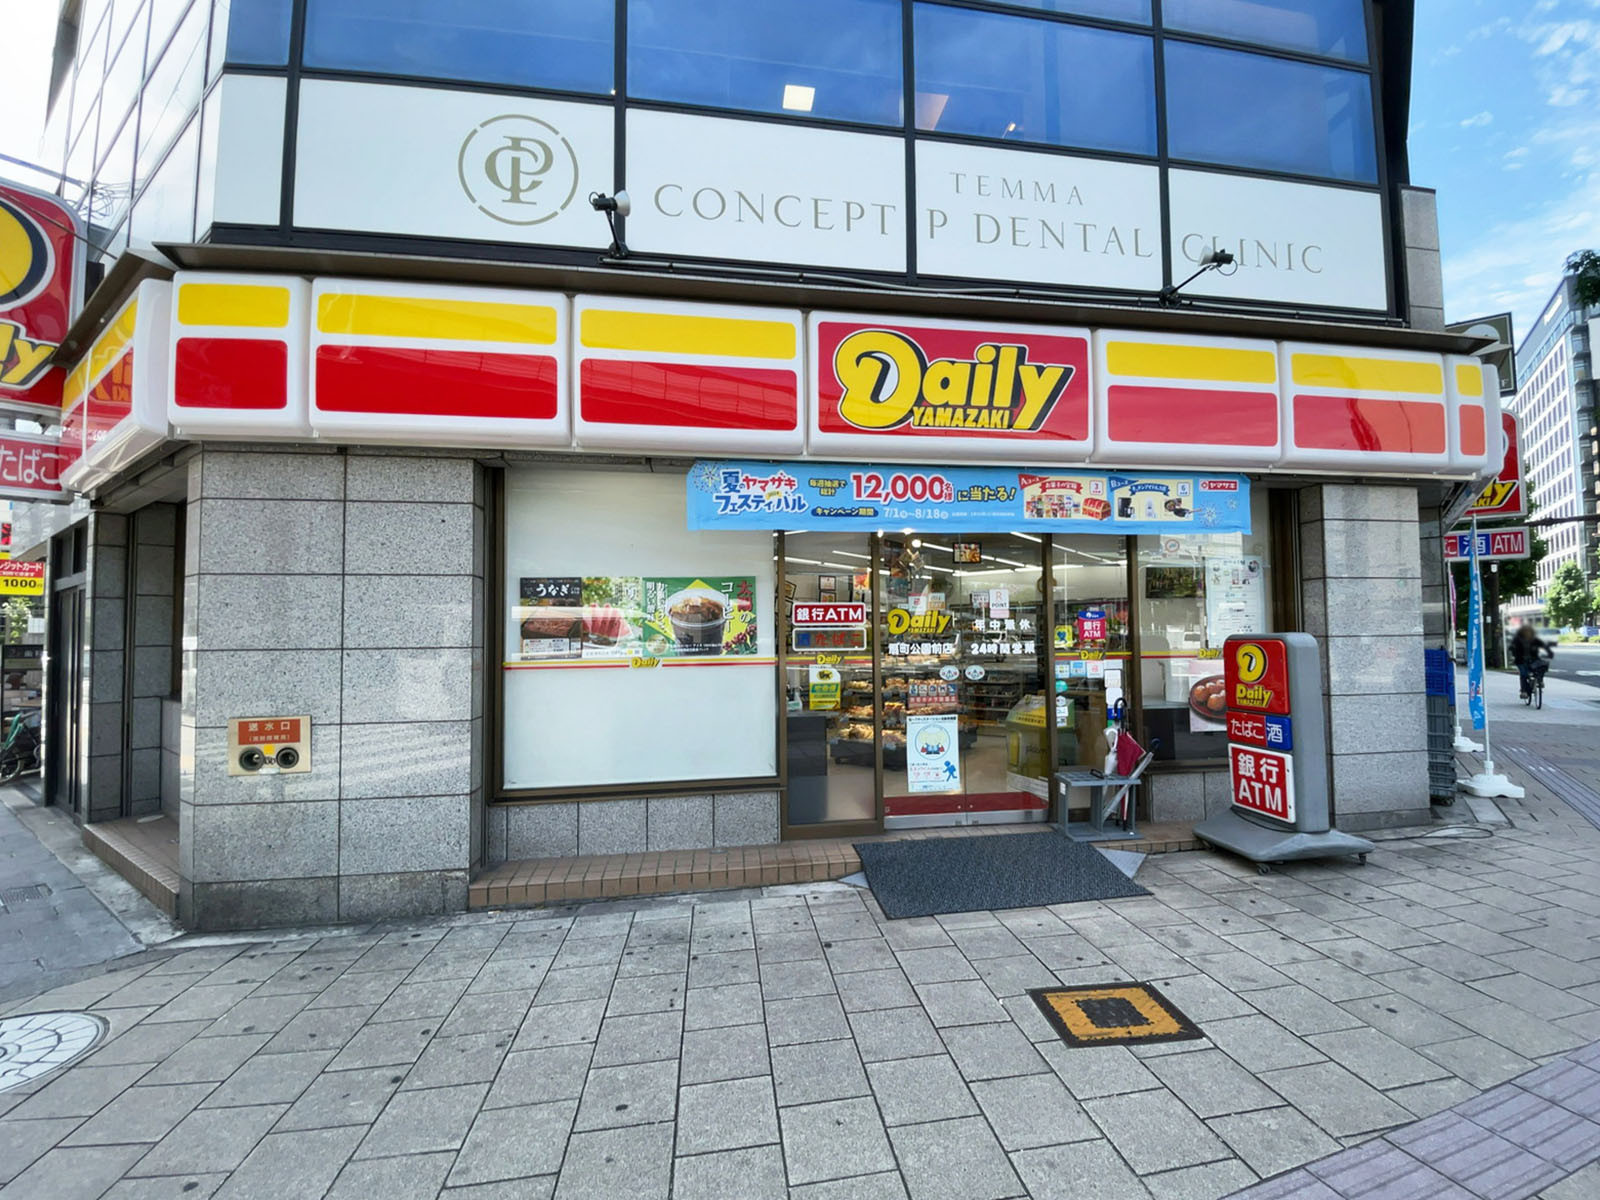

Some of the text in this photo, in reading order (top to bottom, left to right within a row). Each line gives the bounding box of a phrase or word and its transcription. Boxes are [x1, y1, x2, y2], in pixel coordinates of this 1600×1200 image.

[949, 171, 1085, 206] TEMMA
[654, 184, 897, 236] CONCEPT
[926, 208, 948, 240] P
[974, 213, 1153, 259] DENTAL
[835, 330, 1074, 431] Daily
[913, 406, 1010, 428] YAMAZAKI
[721, 470, 797, 493] 夏のヤマザキ
[715, 493, 806, 513] フェスティバル
[1493, 533, 1523, 553] ATM
[536, 583, 570, 598] うなぎ
[721, 581, 736, 633] コーヒー
[796, 608, 863, 622] 銀行ATM
[991, 601, 1008, 609] POINT
[887, 608, 952, 635] Daily
[1084, 621, 1101, 631] 銀行
[816, 653, 842, 664] Daily
[970, 641, 1036, 655] 24時間営業
[631, 657, 661, 669] Daily
[1235, 683, 1273, 708] Daily
[1230, 718, 1284, 744] たばこ 酒
[1237, 752, 1280, 784] 銀行
[1238, 778, 1283, 813] ATM
